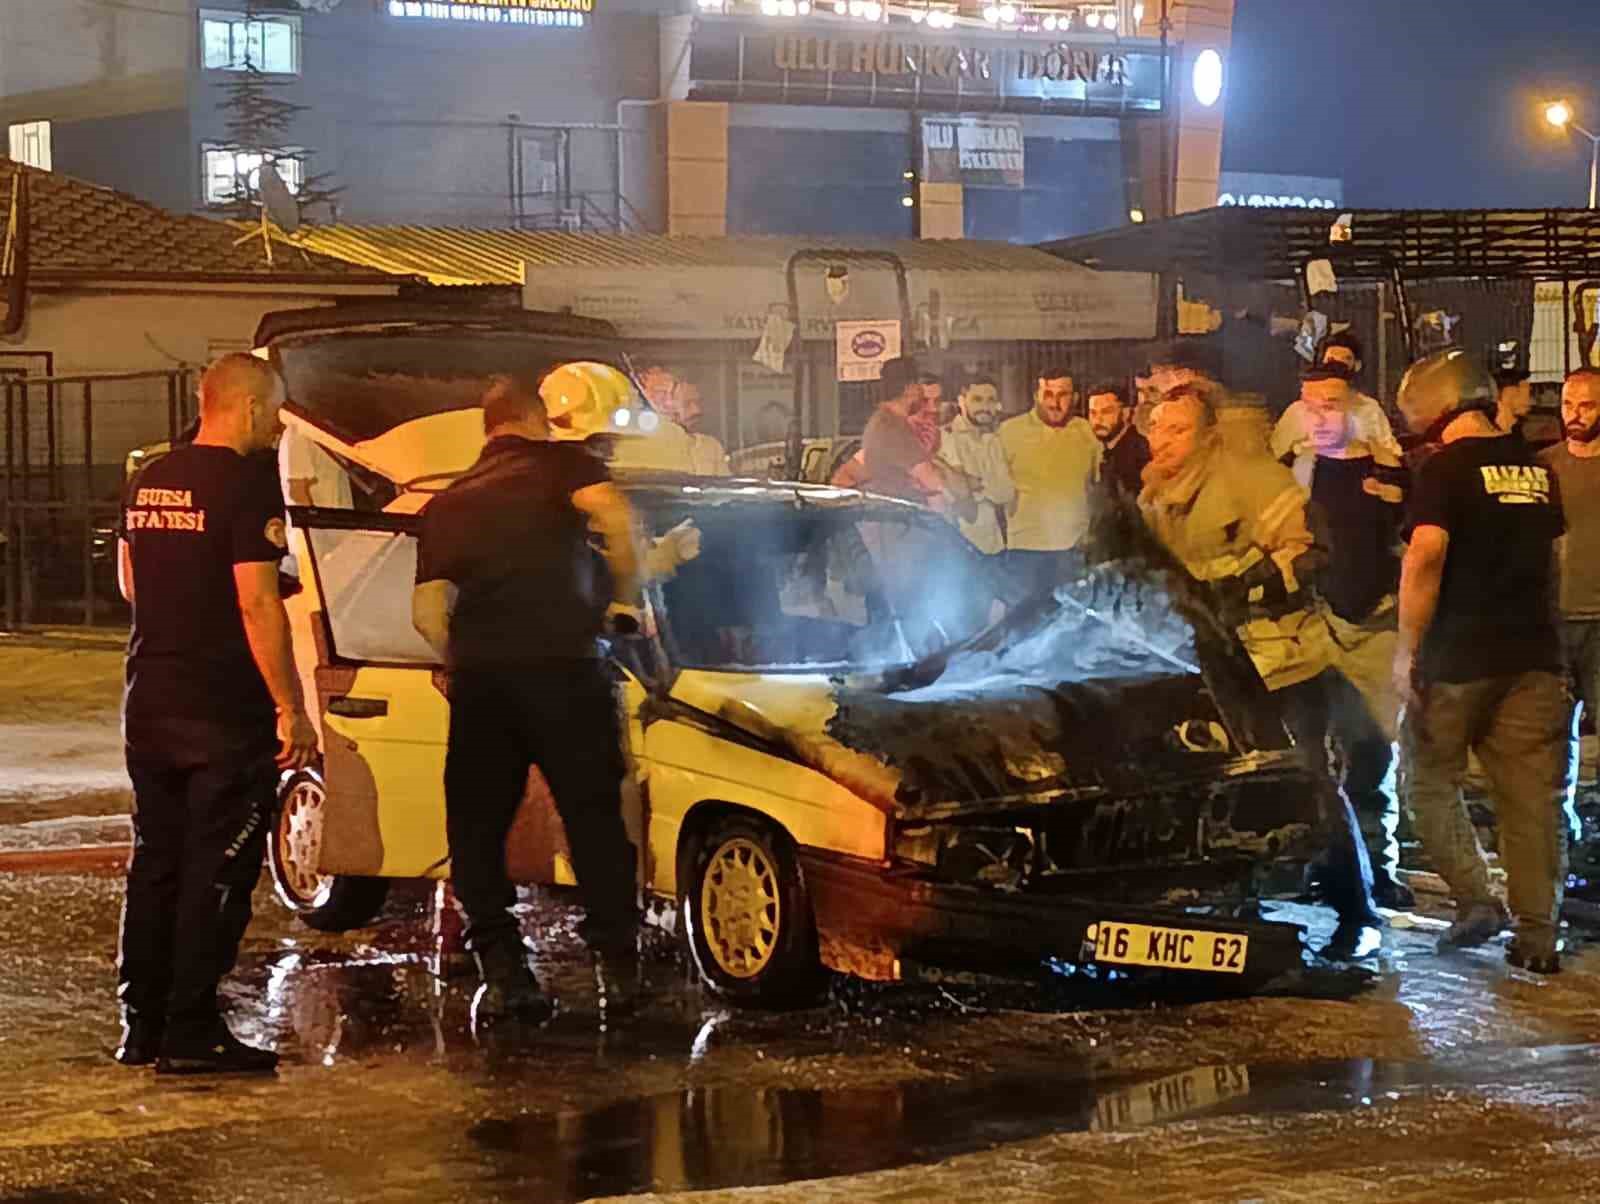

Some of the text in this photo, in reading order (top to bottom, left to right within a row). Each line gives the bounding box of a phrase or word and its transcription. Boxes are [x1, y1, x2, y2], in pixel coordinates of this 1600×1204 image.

[1102, 926, 1243, 969] 16 KHC 62
